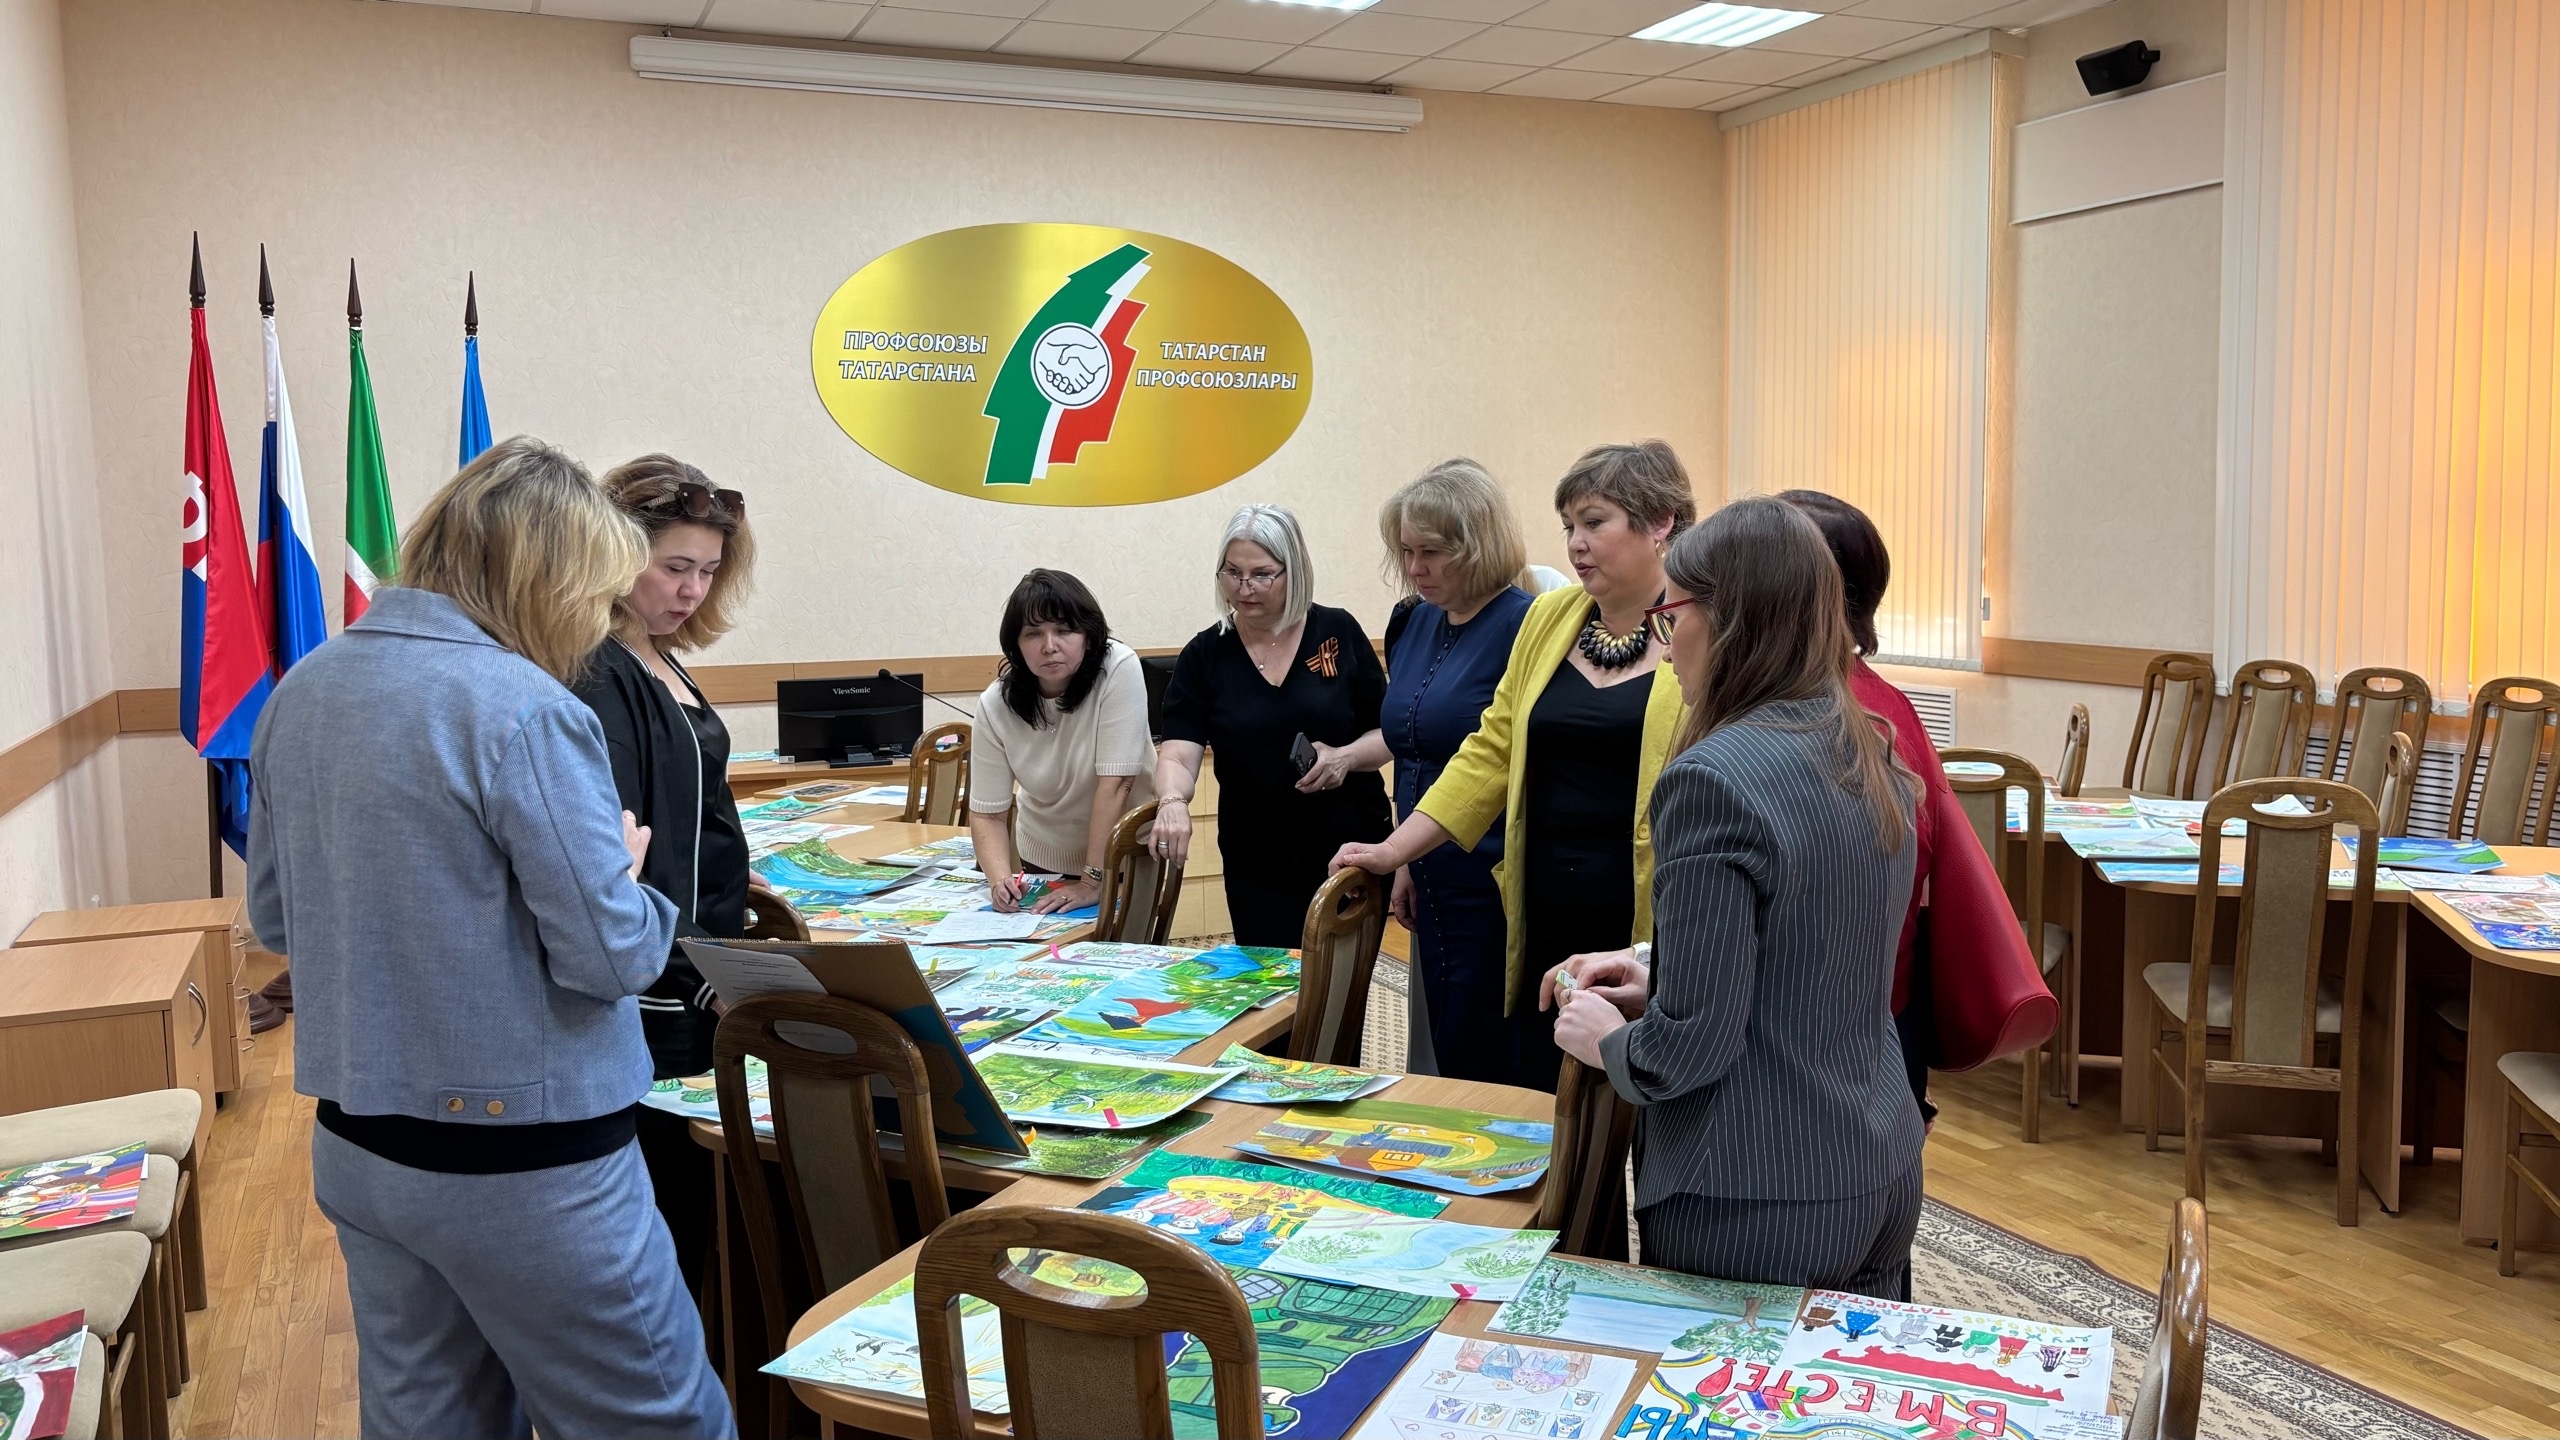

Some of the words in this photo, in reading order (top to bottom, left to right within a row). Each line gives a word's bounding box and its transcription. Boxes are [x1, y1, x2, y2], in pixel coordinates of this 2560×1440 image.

[844, 331, 988, 354] ПРОФСОЮЗЫ
[1160, 342, 1267, 362] ТАТАРСТАН
[839, 360, 977, 382] ТАТАРСТАНА
[1135, 369, 1298, 390] ПРОФСОЮЗЛАРЫ
[832, 686, 871, 695] ViewSonic
[1813, 1290, 1952, 1316] ТАТАРСТАНА
[1696, 1358, 2008, 1437] ВМЕСТЕ!
